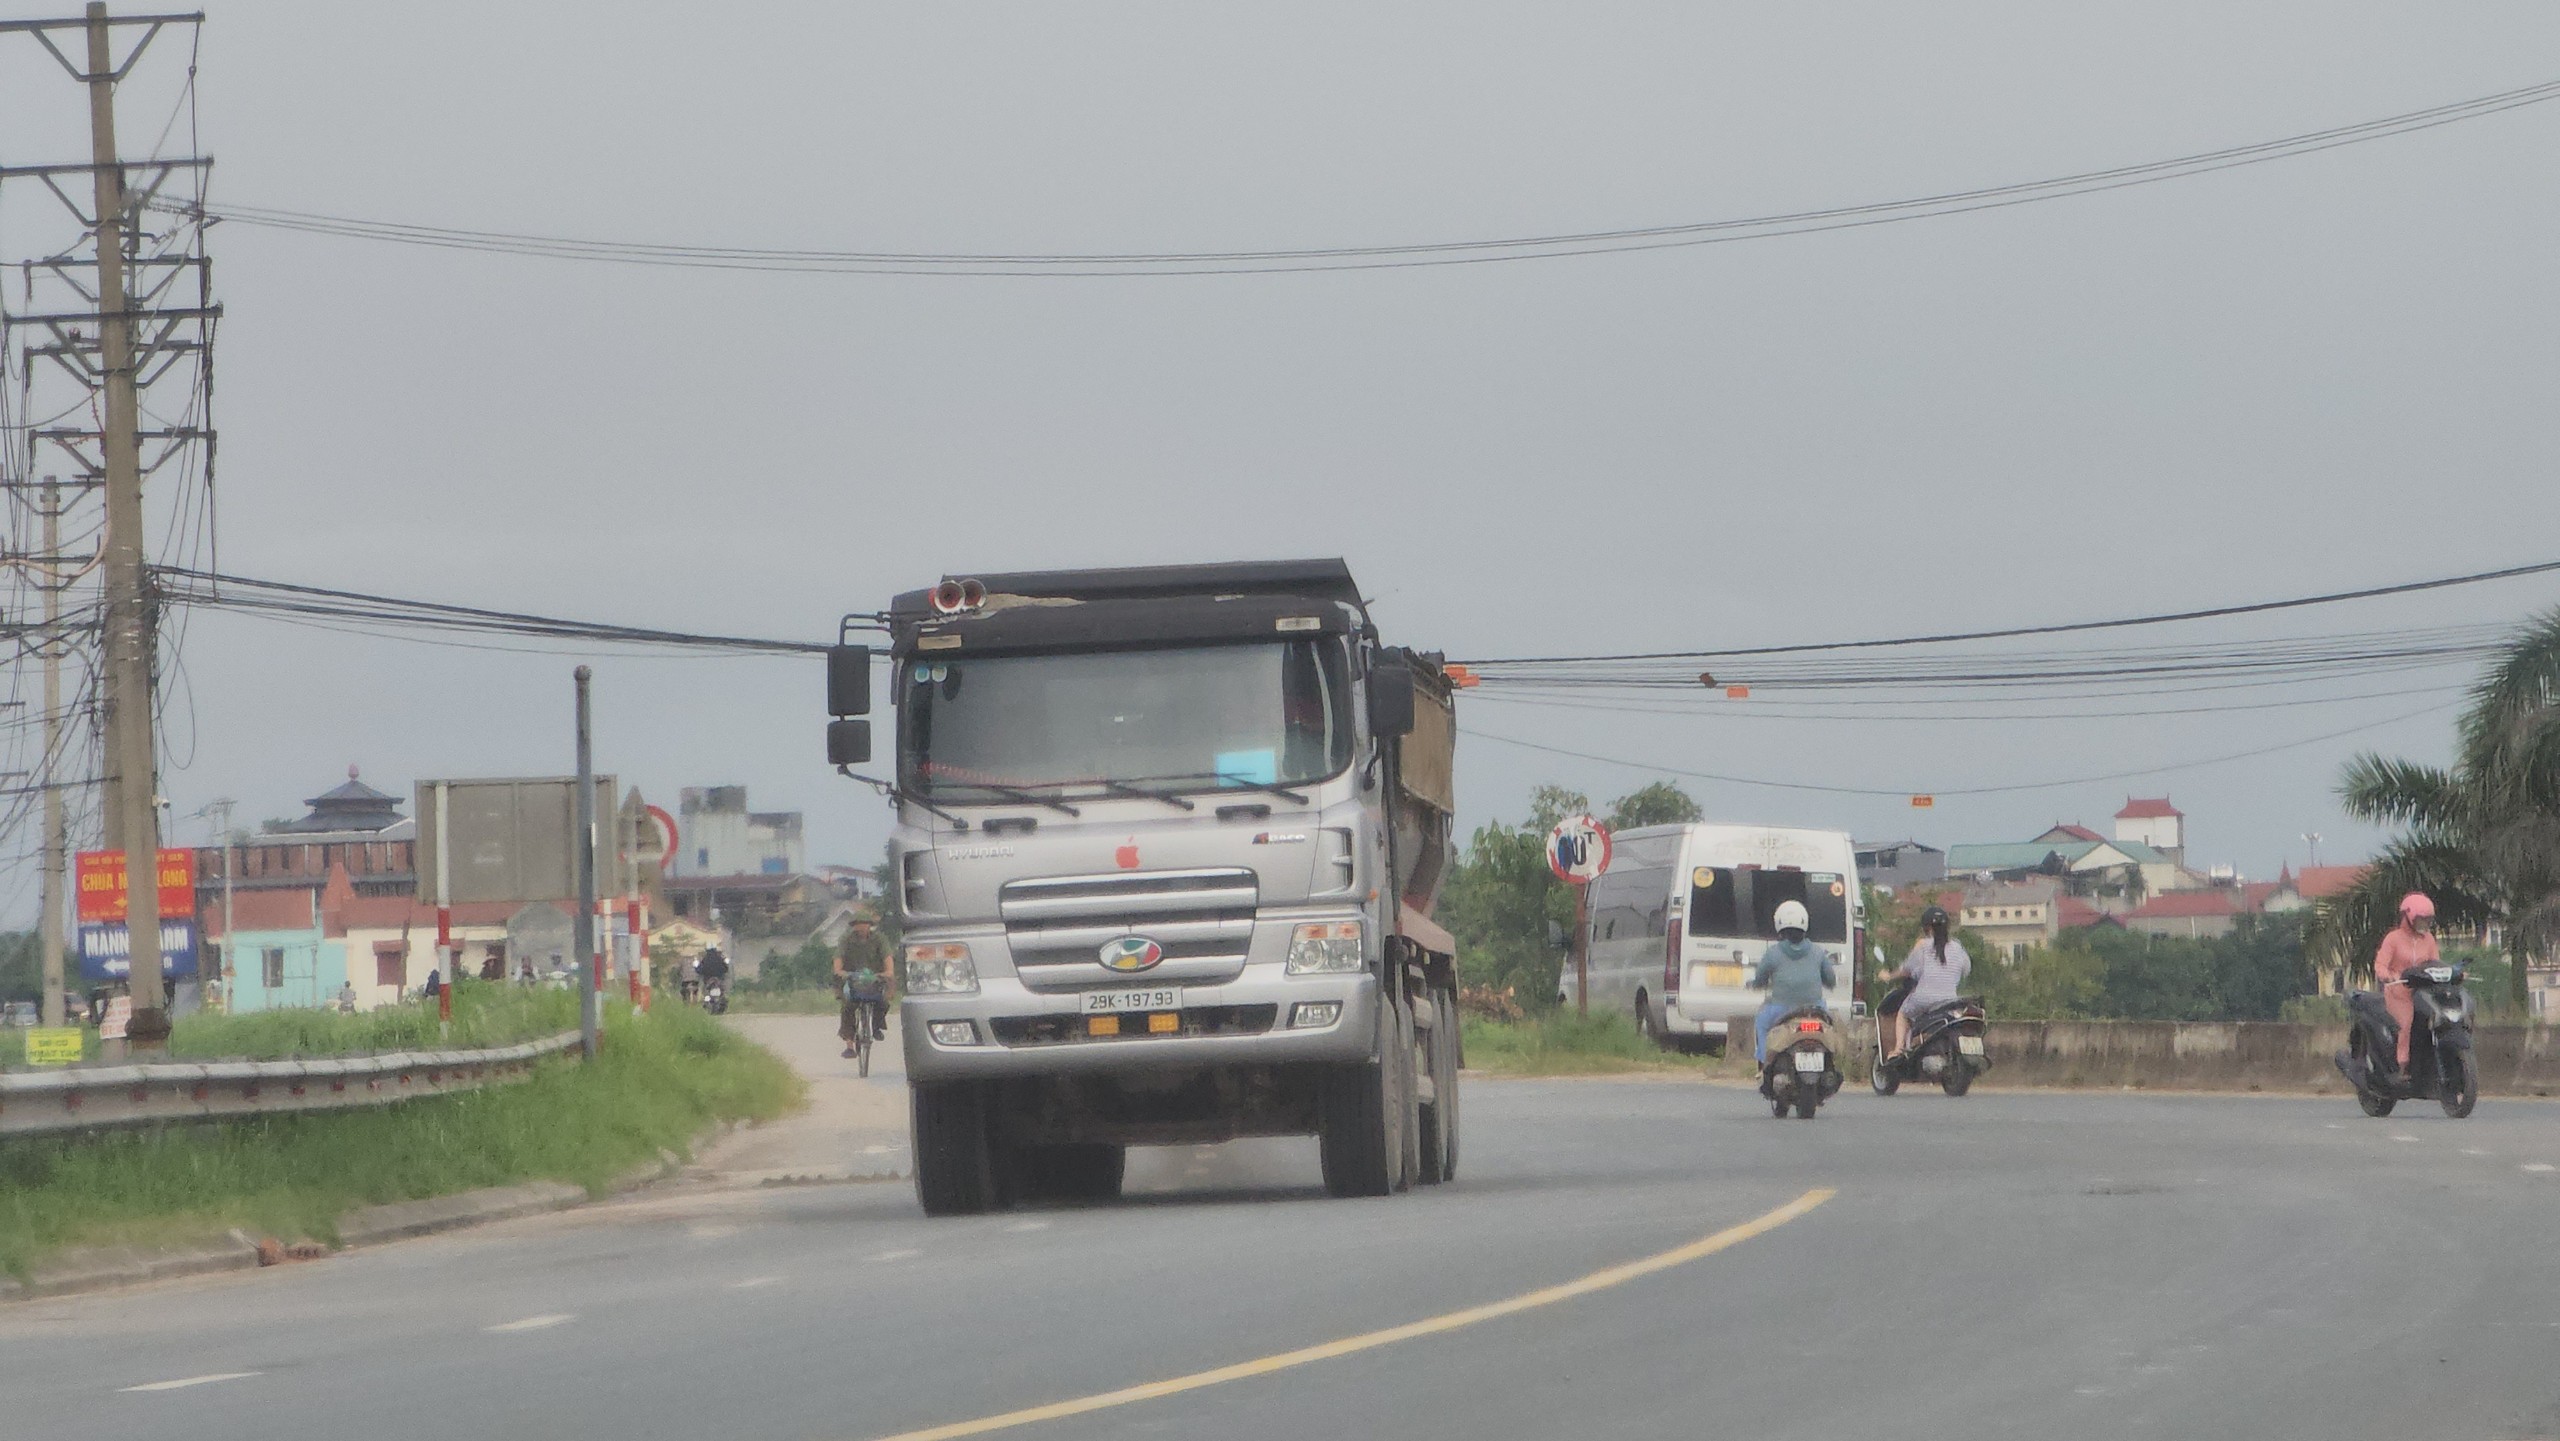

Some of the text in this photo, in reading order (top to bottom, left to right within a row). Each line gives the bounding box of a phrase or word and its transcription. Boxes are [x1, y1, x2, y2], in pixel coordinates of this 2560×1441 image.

[949, 846, 1014, 860] HYUNDAI
[85, 929, 129, 958] MANN
[1089, 991, 1174, 1010] 29K-197.93
